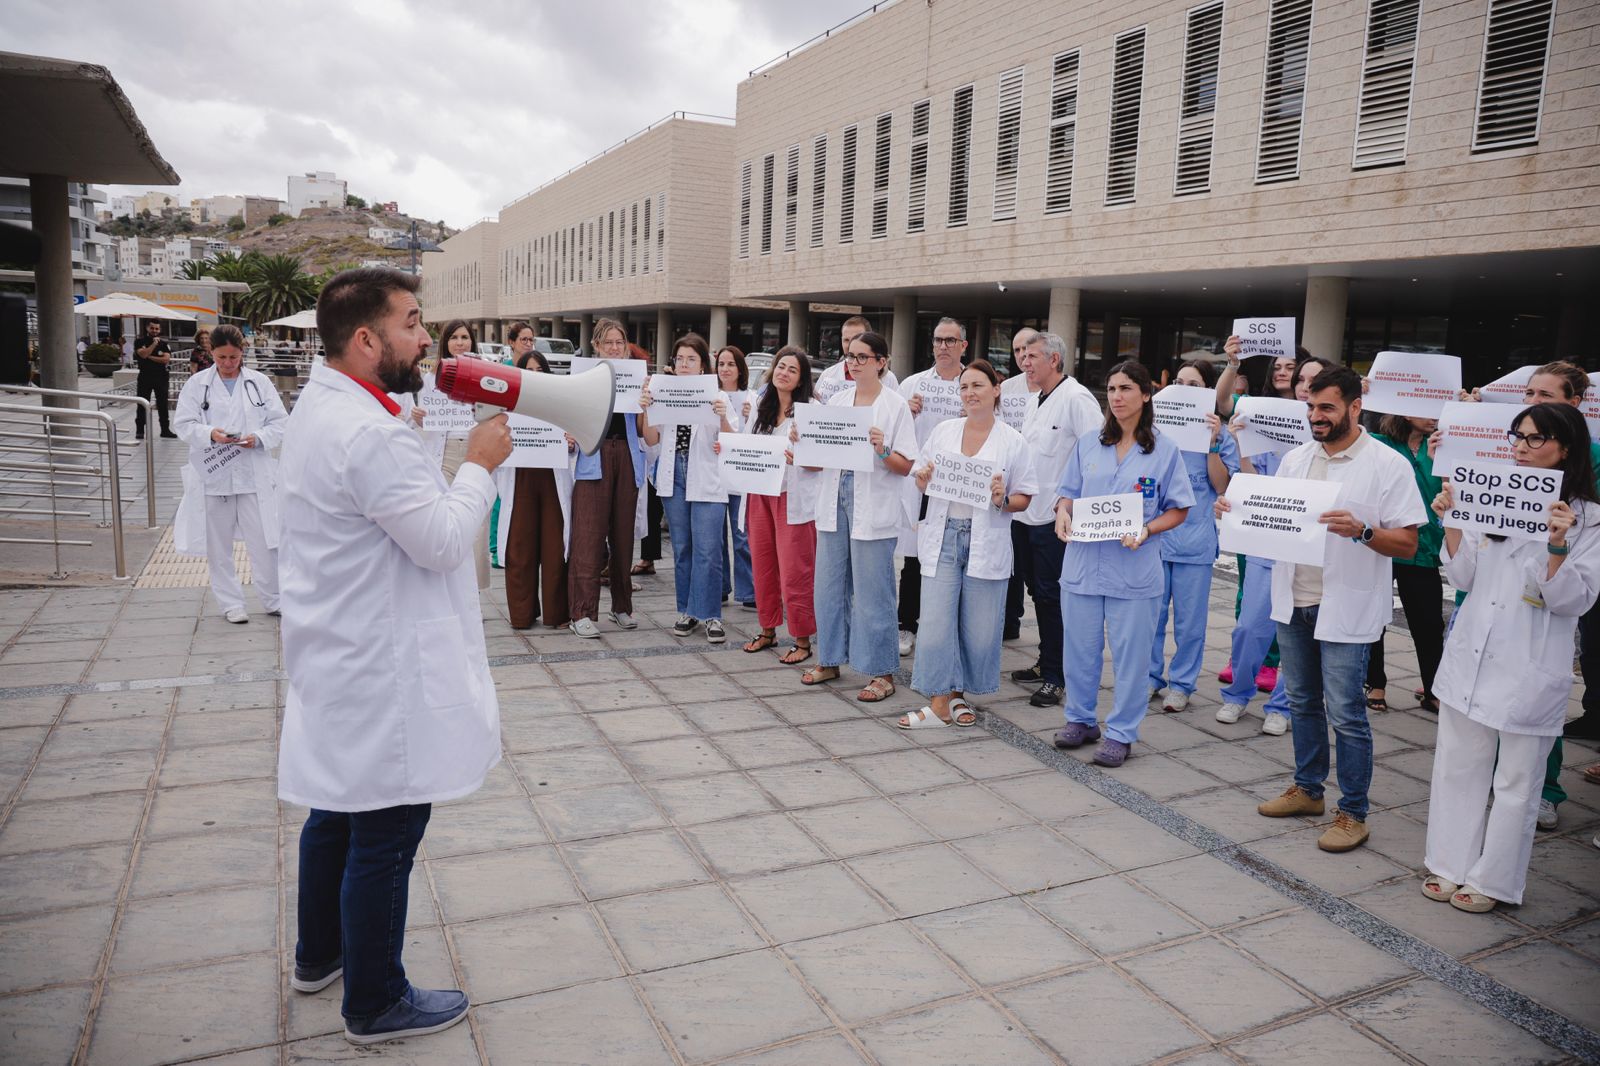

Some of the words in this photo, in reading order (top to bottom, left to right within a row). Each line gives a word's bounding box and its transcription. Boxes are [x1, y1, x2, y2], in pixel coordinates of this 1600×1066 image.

[1248, 322, 1276, 334] SCS
[1260, 338, 1282, 347] deja
[1242, 346, 1257, 354] sin
[1374, 375, 1429, 384] NOMBRAMIENTOS
[821, 381, 840, 392] Stop
[920, 381, 945, 395] Stop
[423, 396, 449, 408] Stop
[932, 396, 952, 406] OPE
[1396, 391, 1454, 401] ENTENDIMIENTO
[1003, 397, 1027, 408] SCS
[438, 408, 458, 417] OPE
[943, 409, 963, 417] jueg
[1153, 413, 1185, 421] AMIENTOS
[1249, 418, 1305, 431] NOMBRAMIENTOS
[1265, 415, 1286, 423] LISTAS
[1274, 432, 1295, 440] QUEDA
[1448, 430, 1509, 441] NOMBRAMIENTO
[203, 453, 217, 465] me
[207, 463, 220, 474] sin
[219, 448, 241, 468] plaza
[935, 453, 961, 471] Stop
[965, 461, 993, 478] SCS
[936, 469, 946, 480] la
[948, 472, 970, 486] OPE
[972, 480, 985, 489] no
[1453, 467, 1502, 490] Stop
[1508, 473, 1556, 494] SCS
[930, 483, 942, 492] es
[944, 486, 957, 496] un
[958, 487, 987, 503] juego
[1262, 496, 1286, 504] LISTAS
[1460, 490, 1474, 503] la
[1479, 493, 1516, 509] OPE
[1521, 500, 1543, 513] no
[1091, 500, 1122, 515] SCS
[1242, 500, 1307, 513] NOMBRAMIENTOS
[1080, 519, 1122, 530] engaña
[1125, 519, 1132, 527] a
[1251, 513, 1268, 522] SOLO
[1269, 516, 1292, 525] QUEDA
[1451, 509, 1470, 521] es
[1475, 513, 1495, 525] un
[1498, 514, 1549, 534] juego
[1241, 519, 1302, 533] ENFRENTAMIENTO
